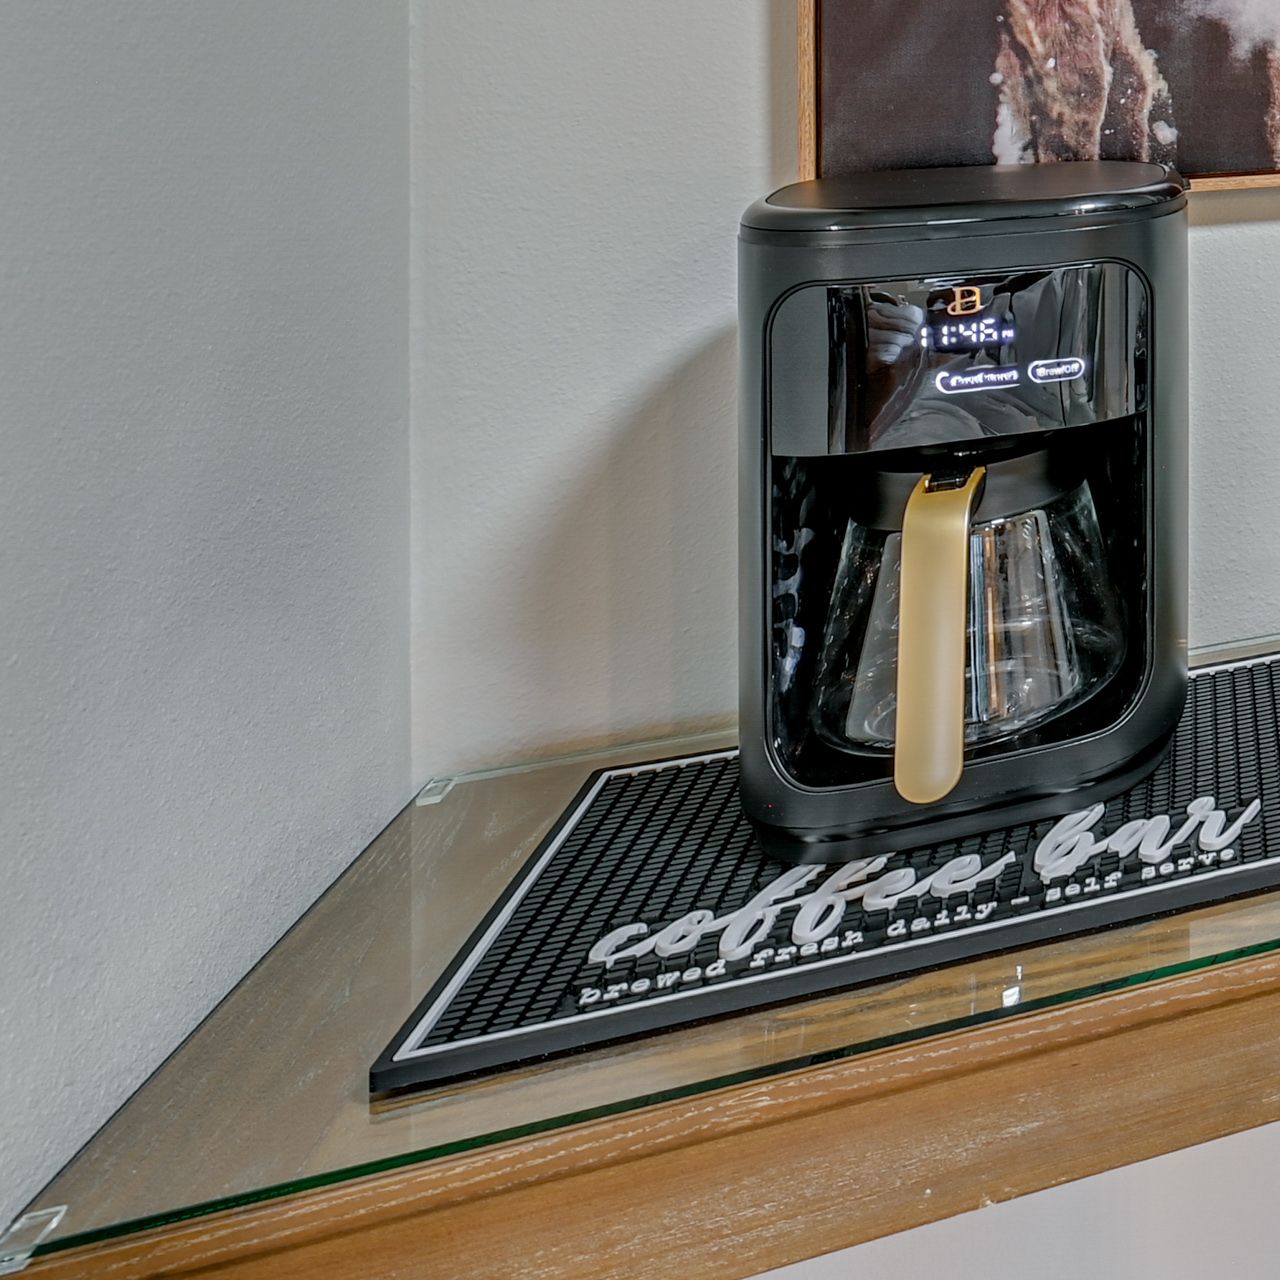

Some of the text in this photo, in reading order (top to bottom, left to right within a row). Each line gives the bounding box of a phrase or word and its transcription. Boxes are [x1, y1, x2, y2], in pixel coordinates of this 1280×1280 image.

[578, 959, 727, 1005] brewed
[750, 930, 864, 967] fresh
[886, 901, 997, 938] daily
[1045, 871, 1122, 902] self
[1142, 847, 1235, 879] serve
[588, 796, 1261, 964] coffee bar
